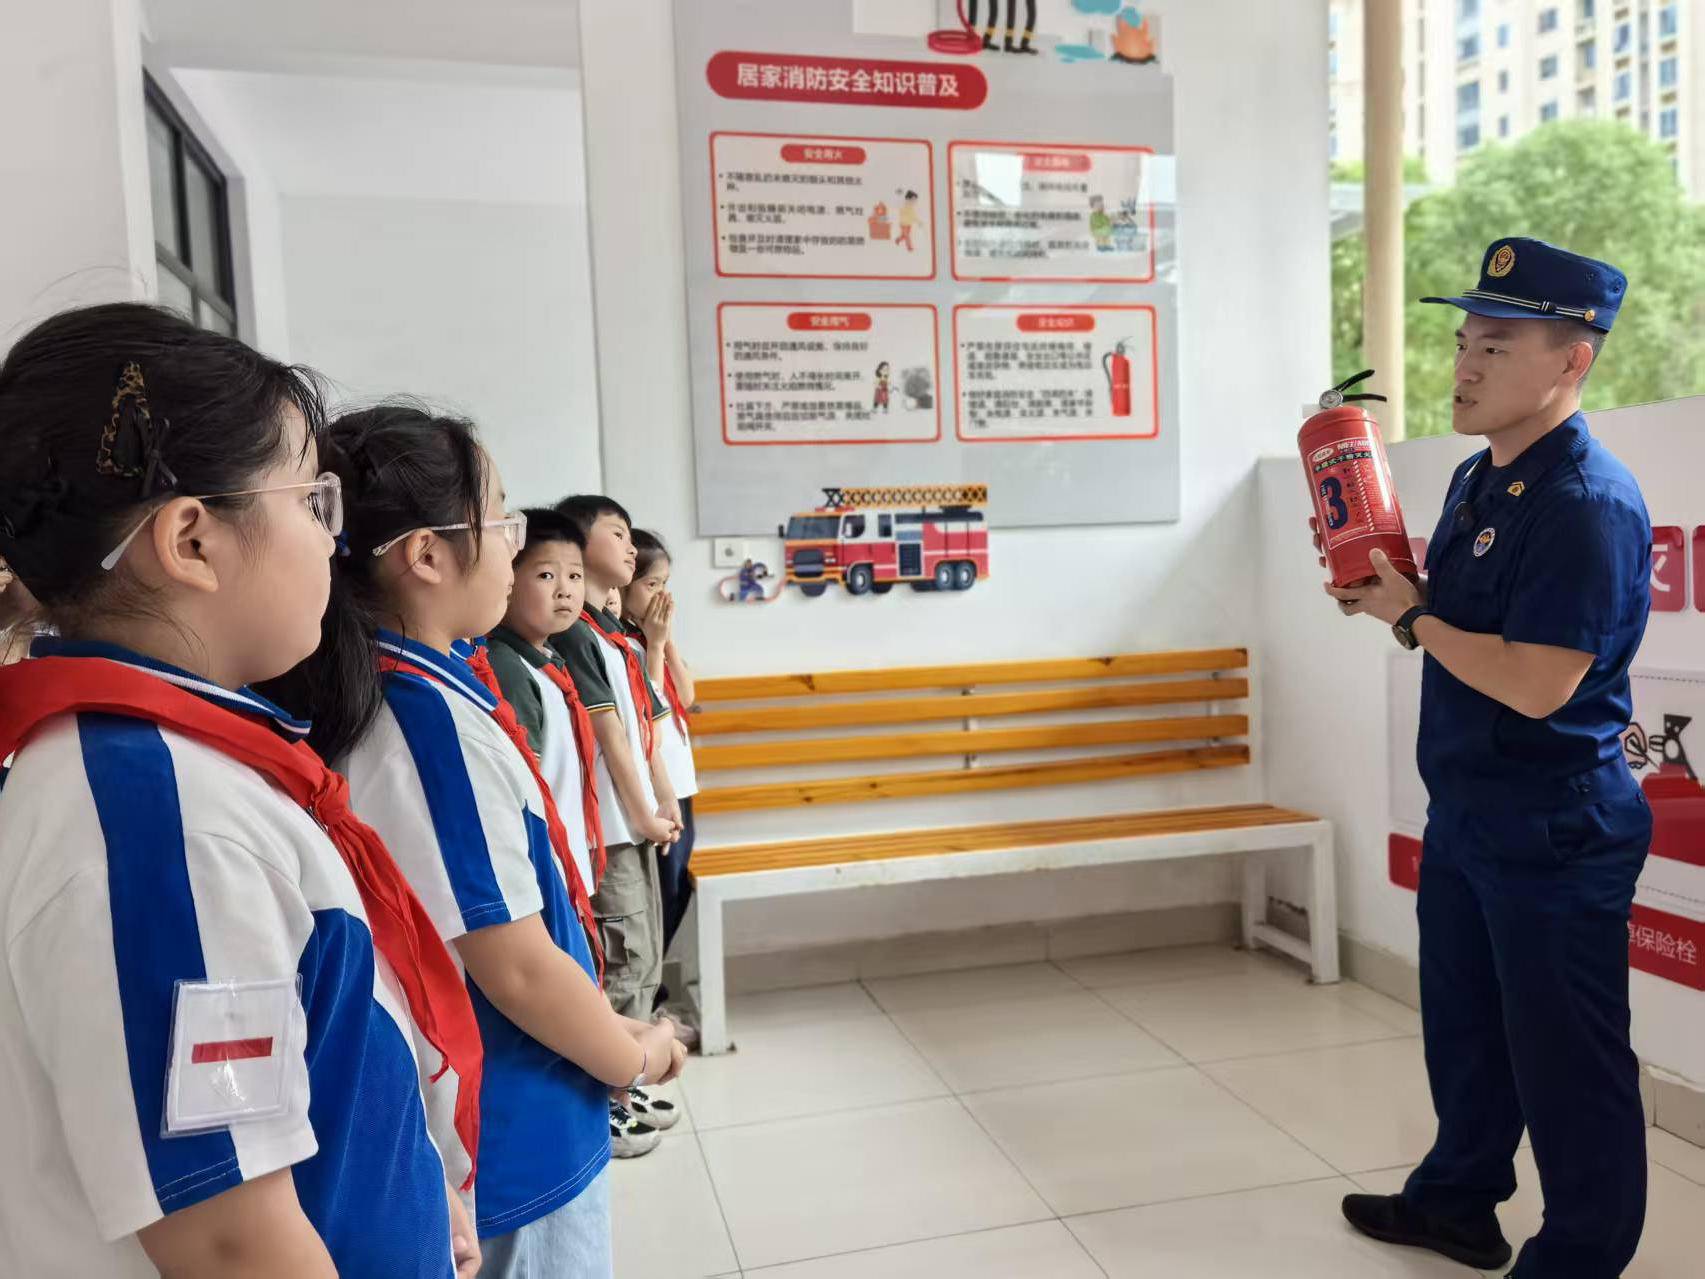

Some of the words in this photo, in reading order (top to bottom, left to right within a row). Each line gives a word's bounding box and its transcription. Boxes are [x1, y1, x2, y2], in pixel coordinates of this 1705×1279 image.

[736, 62, 960, 97] 居家消防安全知识普及
[1319, 476, 1348, 530] 3
